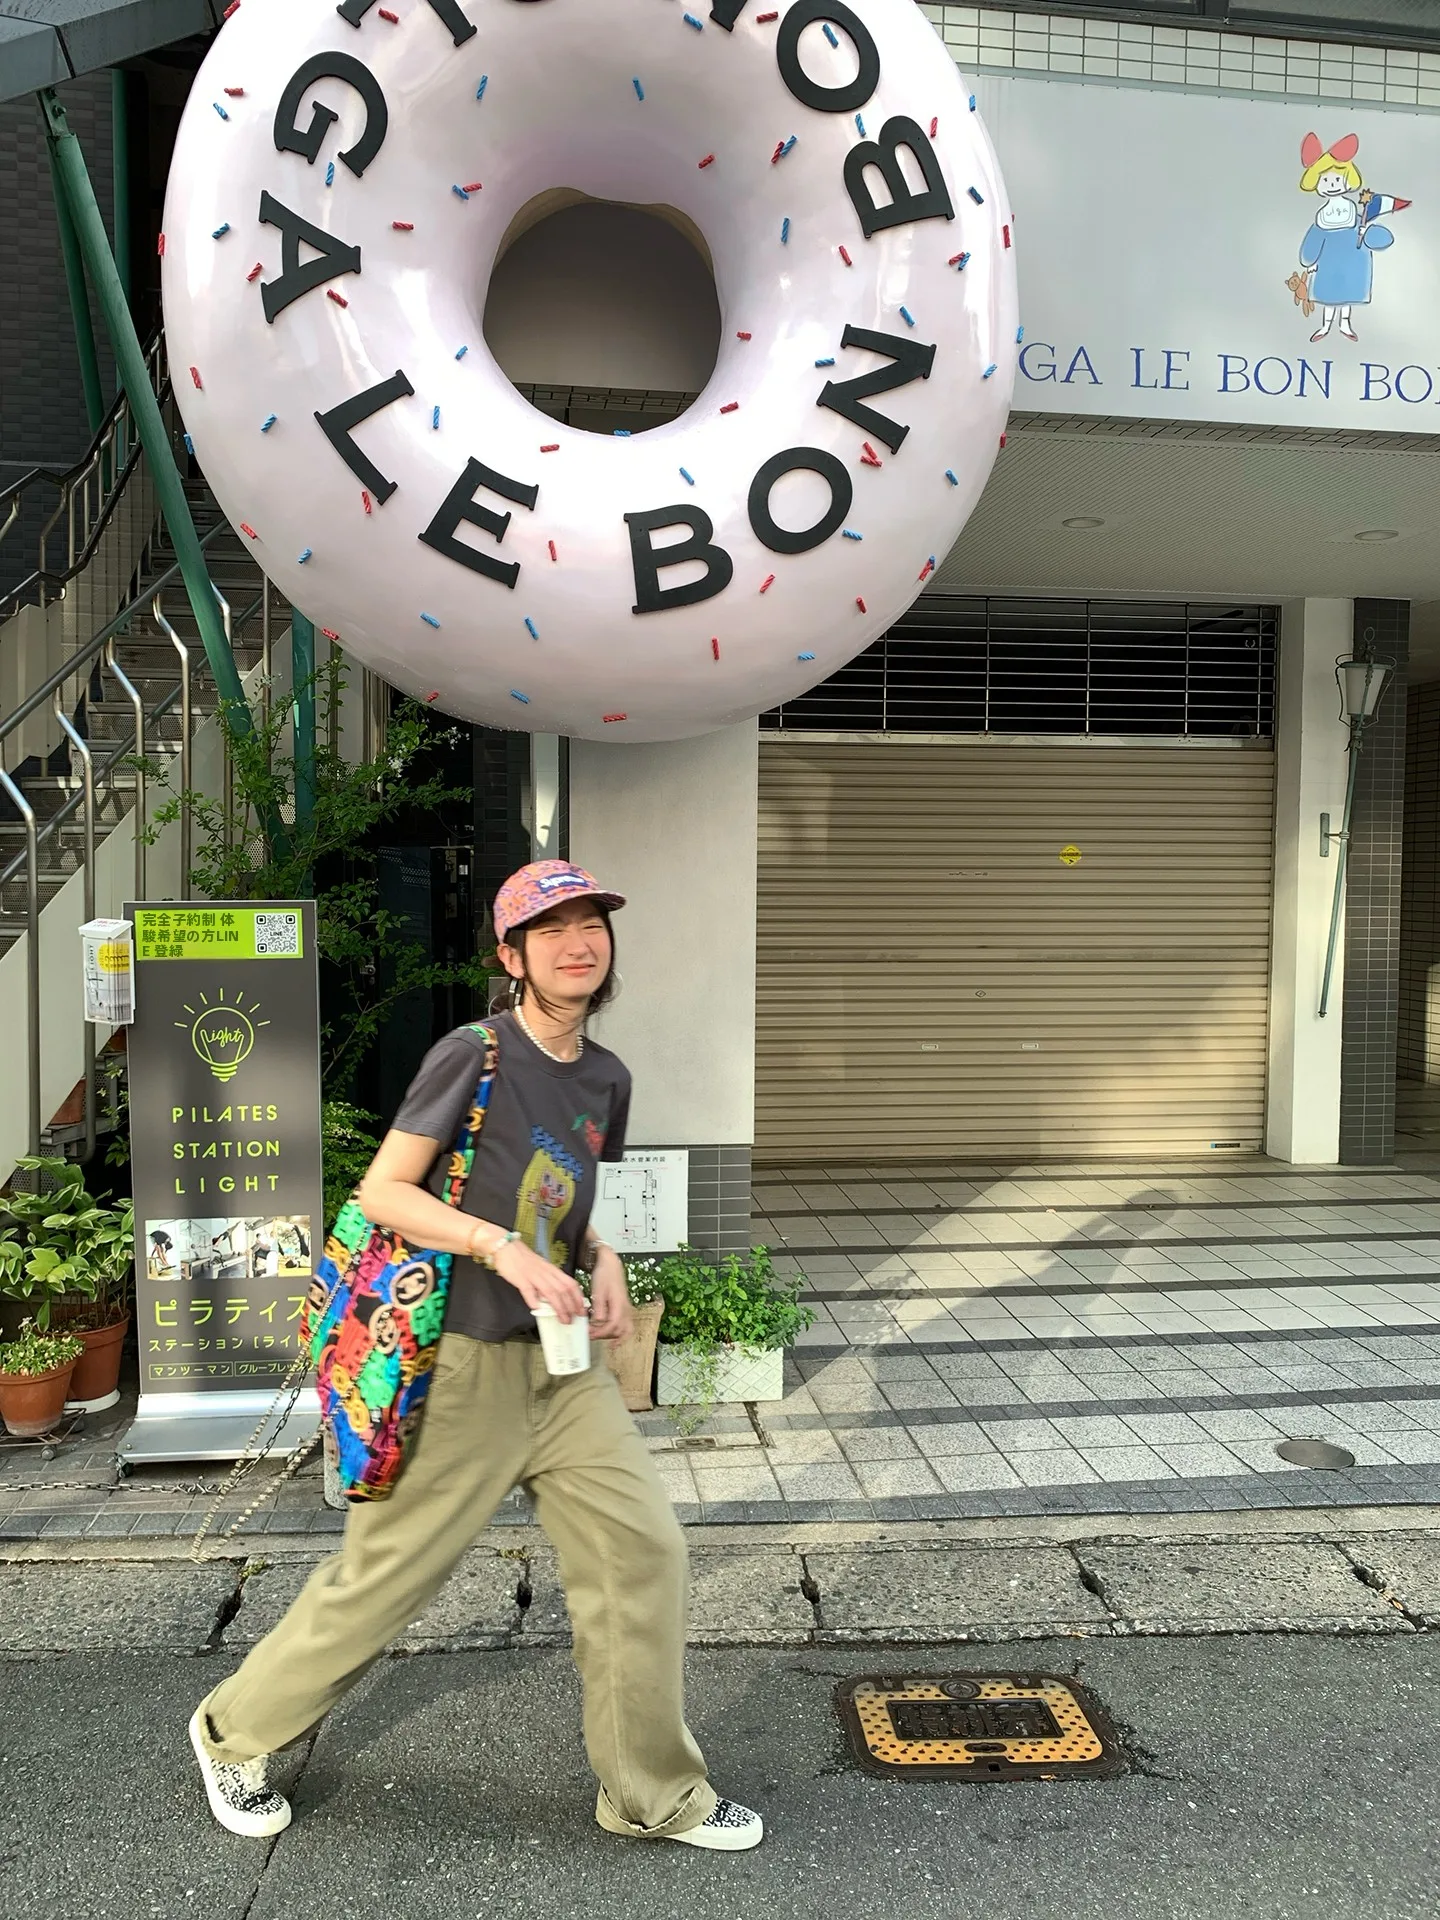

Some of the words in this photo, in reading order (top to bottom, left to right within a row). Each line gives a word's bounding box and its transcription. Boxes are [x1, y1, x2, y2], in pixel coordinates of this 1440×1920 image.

[710, 0, 955, 240] BO
[1129, 347, 1191, 391] LE
[1216, 354, 1335, 400] BON
[1359, 362, 1440, 406] BO
[313, 368, 540, 589] LE
[622, 323, 938, 614] BON
[172, 1105, 279, 1124] PILATES
[173, 1140, 280, 1160] STATION
[175, 1175, 279, 1194] LIGHT
[155, 1296, 307, 1327] ピラティス
[153, 1364, 231, 1377] マンツーマン
